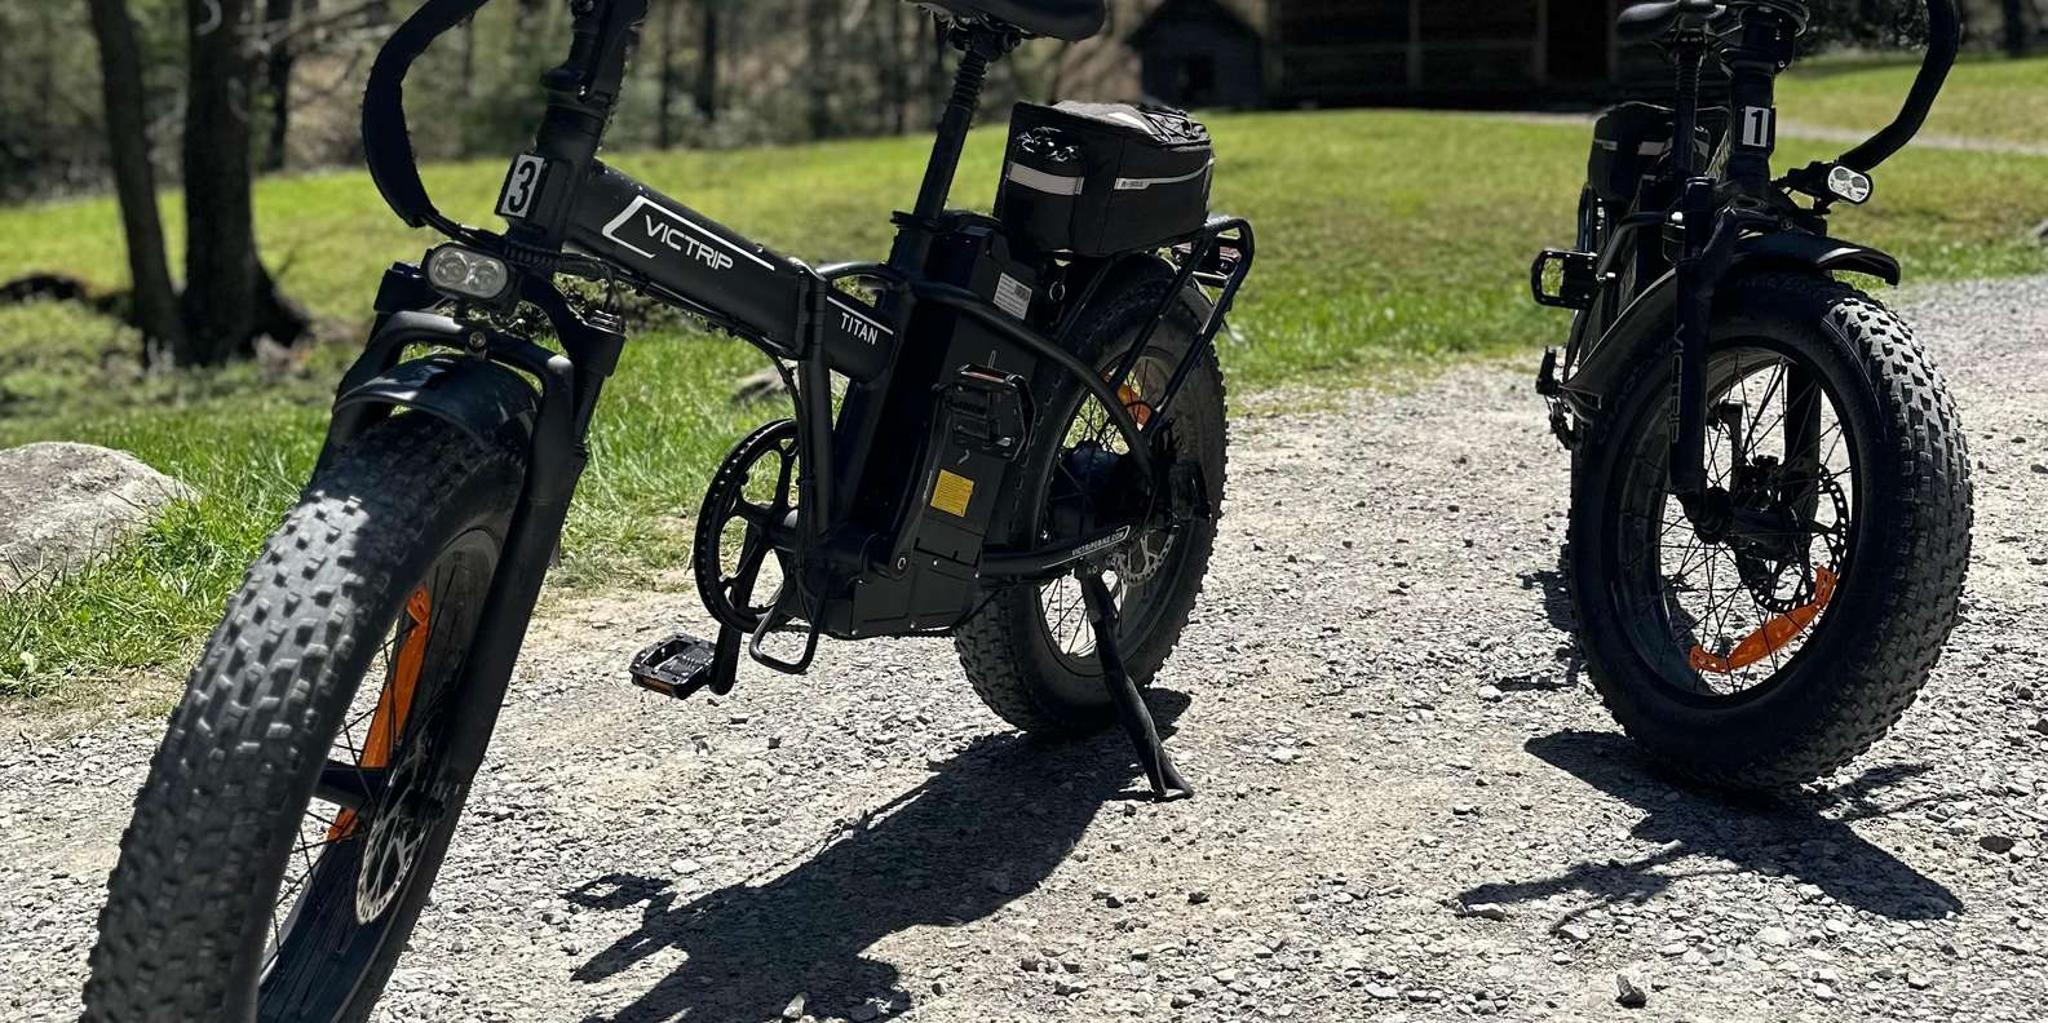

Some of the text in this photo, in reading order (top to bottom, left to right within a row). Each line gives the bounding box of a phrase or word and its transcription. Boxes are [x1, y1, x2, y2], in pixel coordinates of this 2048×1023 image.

[1751, 109, 1764, 145] 1
[508, 160, 537, 212] 3
[645, 214, 734, 271] VICTRIP
[840, 312, 879, 346] TITAN
[1671, 322, 1685, 444] VICTRIP
